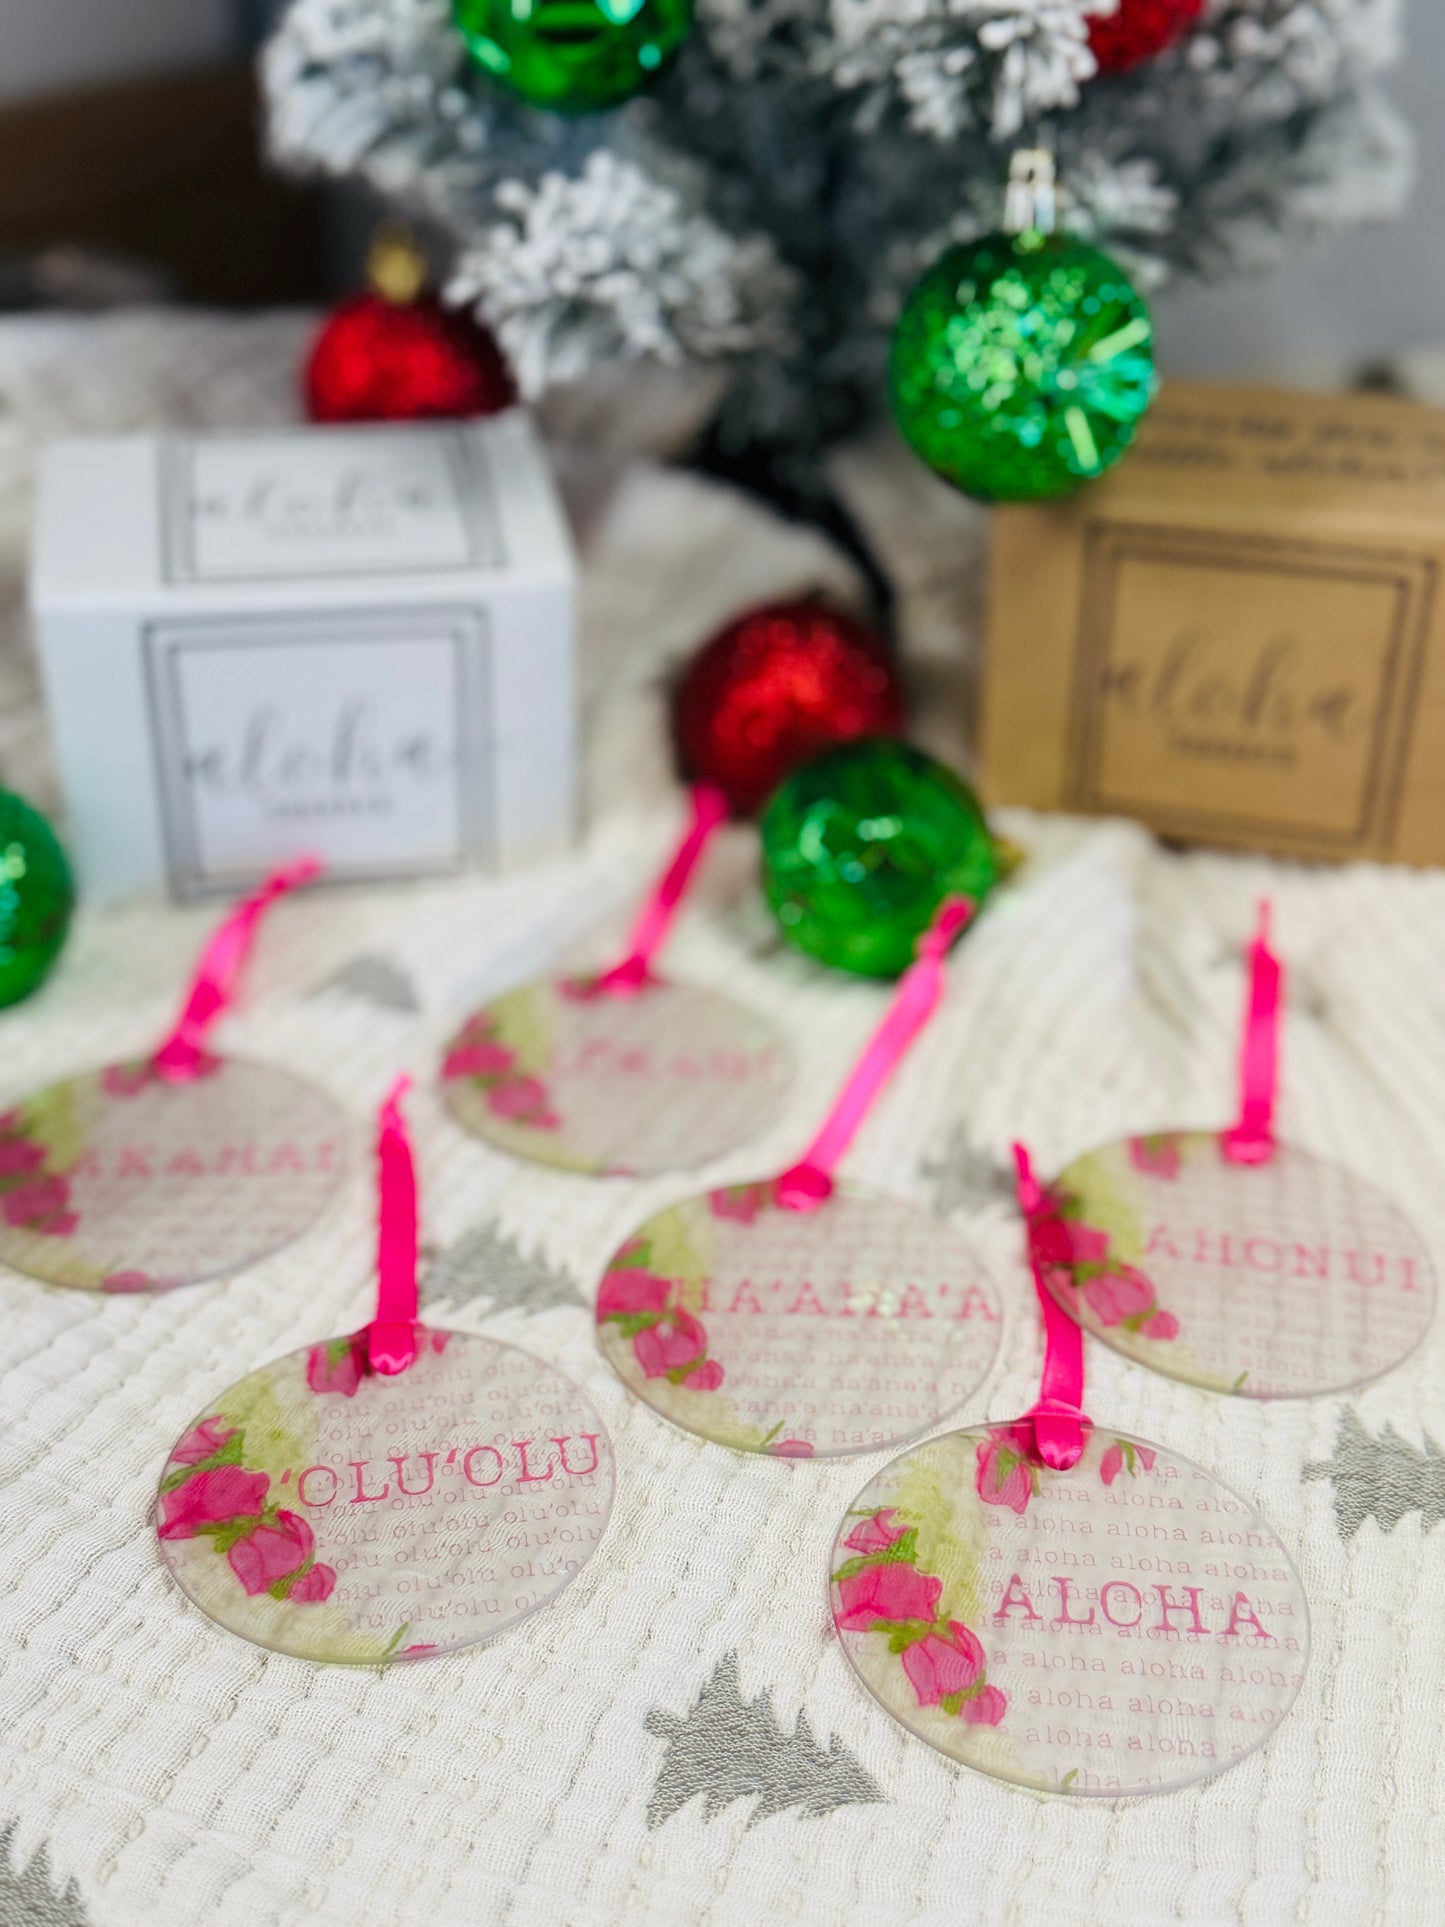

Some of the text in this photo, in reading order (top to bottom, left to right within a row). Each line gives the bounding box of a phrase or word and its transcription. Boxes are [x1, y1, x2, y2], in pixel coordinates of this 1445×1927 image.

[1144, 1223, 1423, 1292] AHONUI
[1103, 1488, 1185, 1511] aloha
[1106, 1516, 1189, 1542] aloha
[1016, 1545, 1097, 1568] aloha
[1110, 1553, 1193, 1576] aloha
[1204, 1561, 1290, 1583] aloha
[991, 1573, 1274, 1638] ALOHA
[1021, 1649, 1107, 1674] aloha
[1120, 1656, 1205, 1681] aloha
[1026, 1687, 1114, 1712] aloha
[1128, 1693, 1215, 1719] aloha
[1025, 1724, 1114, 1749] aloha
[1126, 1732, 1217, 1759] aloha
